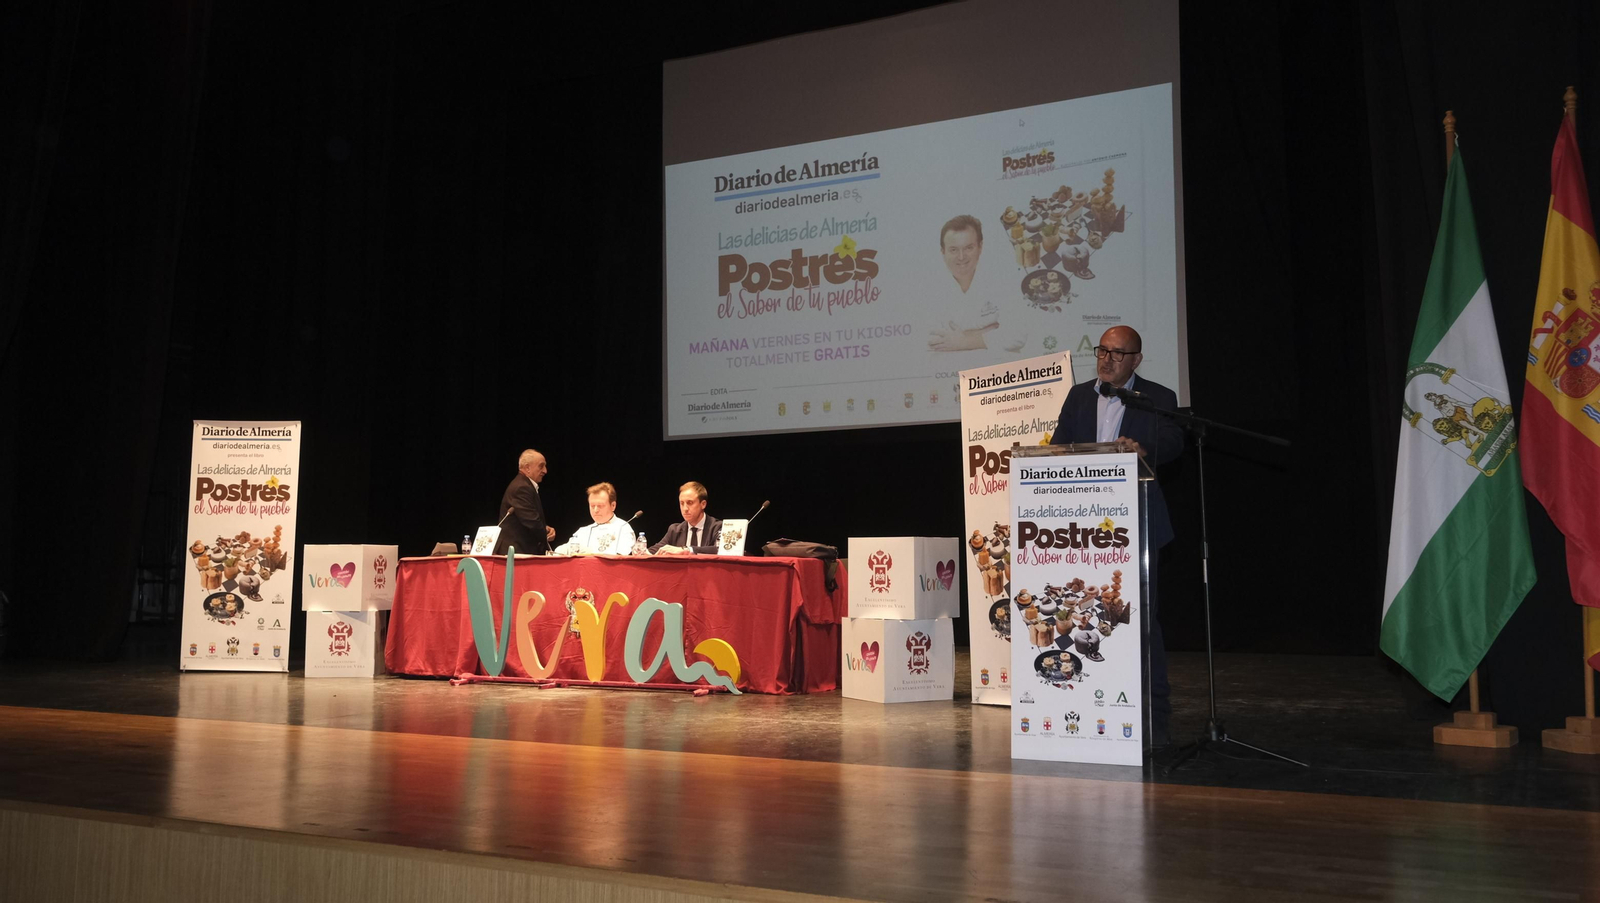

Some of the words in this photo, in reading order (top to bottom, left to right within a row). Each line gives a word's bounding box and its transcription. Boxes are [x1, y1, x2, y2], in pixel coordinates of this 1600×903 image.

[1002, 151, 1055, 172] Postres
[714, 169, 772, 193] Diario
[774, 166, 797, 184] de
[799, 152, 880, 181] Almería
[735, 188, 858, 214] diariodealmeria.es
[718, 232, 743, 250] Las
[744, 226, 797, 246] delicias
[800, 221, 818, 240] de
[820, 212, 878, 238] Almería
[718, 248, 880, 297] Postres
[718, 292, 734, 318] el
[738, 288, 781, 319] Sabor
[786, 287, 805, 312] de
[804, 284, 824, 310] tu
[827, 277, 882, 316] pueblo
[689, 338, 749, 354] MAÑANA
[752, 334, 810, 349] VIERNES
[814, 331, 832, 344] EN
[836, 328, 854, 342] TU
[857, 324, 912, 340] KIOSKO
[726, 350, 810, 369] TOTALMENTE
[814, 345, 870, 362] GRATIS
[968, 374, 1002, 390] Diario
[1003, 371, 1016, 383] de
[1017, 362, 1062, 382] Almería
[710, 388, 728, 396] EDITA
[980, 388, 1052, 405] diariodealmeria.es
[688, 403, 710, 412] Diario
[722, 400, 752, 409] Almería
[996, 407, 1018, 416] presenta
[202, 426, 236, 436] Diario
[236, 427, 248, 436] de
[249, 427, 292, 436] Almería
[968, 428, 983, 442] Las
[984, 424, 1017, 440] delicias
[1018, 420, 1030, 435] de
[1030, 418, 1059, 434] Almer
[212, 442, 280, 450] diariodealmeria.es
[197, 464, 212, 475] Las
[213, 464, 246, 475] delicias
[246, 464, 257, 475] de
[258, 464, 292, 475] Almería
[1020, 468, 1058, 480] Diario
[1059, 467, 1073, 478] de
[1075, 465, 1126, 478] Almería
[196, 477, 290, 502] Postres
[969, 474, 980, 495] el
[981, 472, 1008, 496] Sabor
[1034, 485, 1113, 494] diariodealmeria.es
[194, 499, 205, 515] el
[206, 498, 234, 515] Sabor
[236, 500, 248, 515] de
[248, 500, 259, 516] tu
[260, 499, 290, 519] pueblo
[1018, 506, 1035, 518] Las
[1036, 505, 1074, 518] delicias
[1075, 504, 1087, 517] de
[1088, 503, 1128, 516] Almería
[1018, 521, 1130, 549] Postres
[1017, 547, 1029, 564] el
[1031, 545, 1062, 566] Sabor
[1066, 548, 1078, 564] de
[1078, 546, 1092, 566] tu
[1094, 545, 1131, 569] pueblo
[309, 572, 341, 588] Vera
[919, 574, 943, 592] Vera
[456, 546, 742, 694] Vera
[846, 653, 868, 671] Vera
